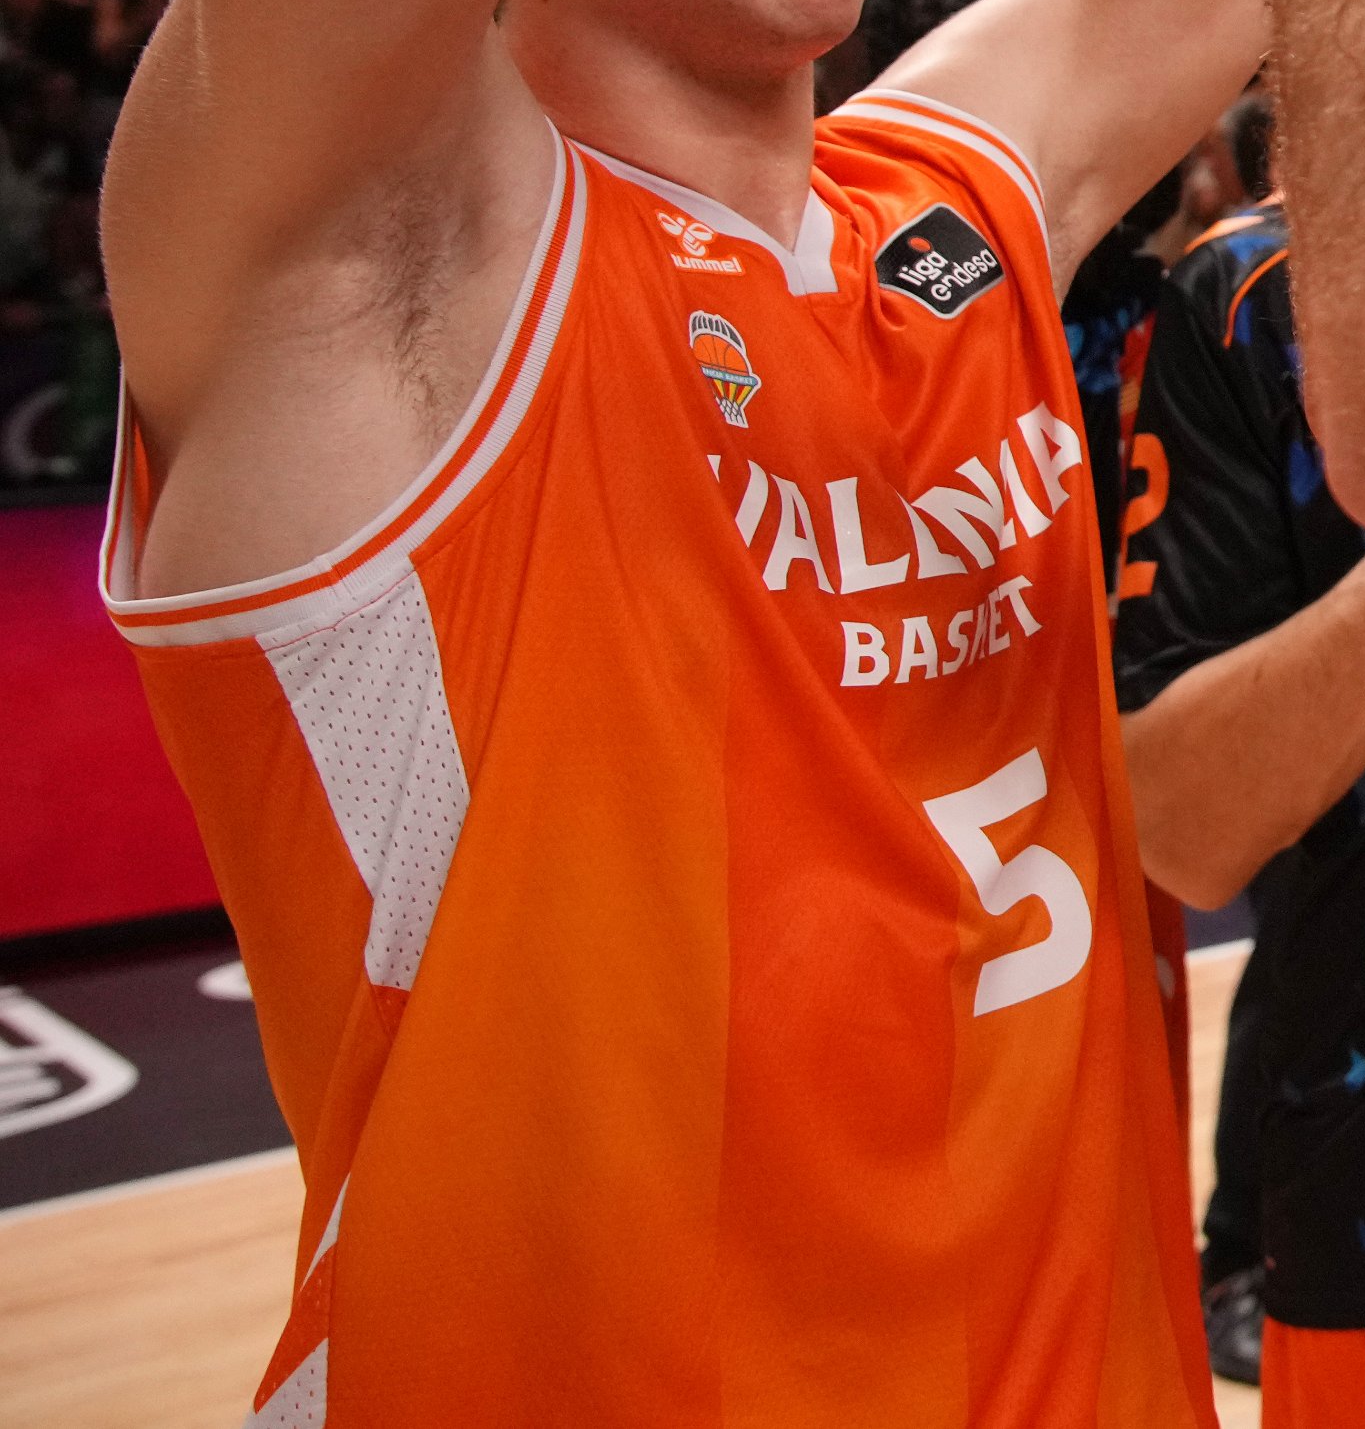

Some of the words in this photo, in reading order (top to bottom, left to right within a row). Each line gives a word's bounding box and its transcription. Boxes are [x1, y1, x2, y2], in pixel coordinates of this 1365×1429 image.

[670, 252, 743, 273] ummel
[898, 250, 949, 287] liga
[930, 248, 998, 302] endesa
[921, 746, 1093, 1019] 5
